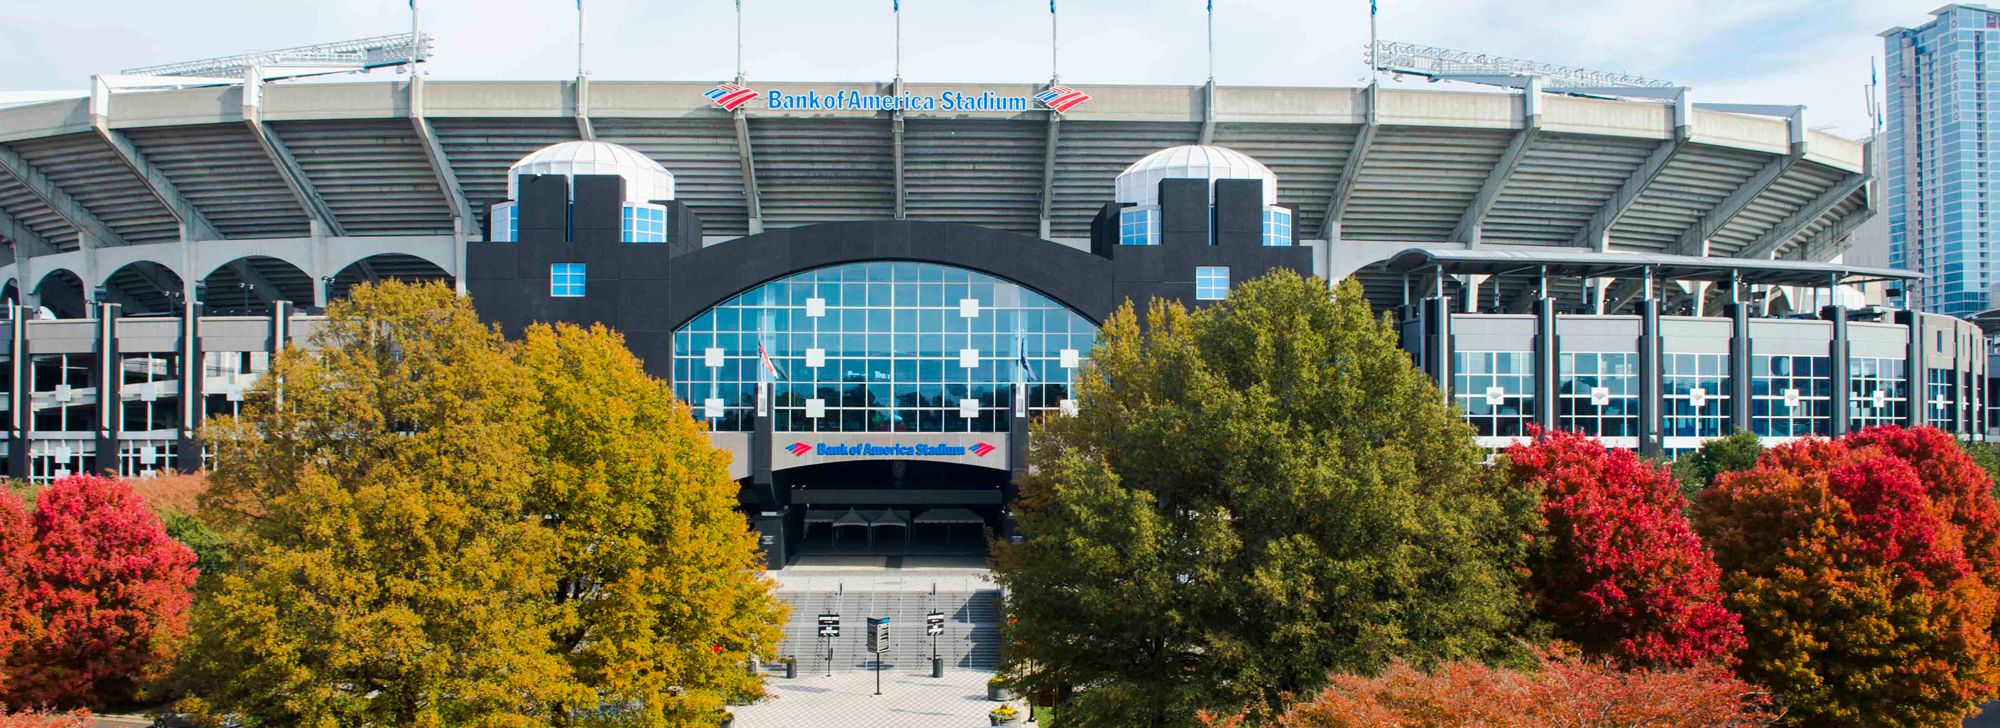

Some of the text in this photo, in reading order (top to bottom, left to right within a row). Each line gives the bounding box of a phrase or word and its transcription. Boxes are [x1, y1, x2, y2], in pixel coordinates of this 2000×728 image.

[1950, 9, 1958, 41] NOW
[768, 89, 1027, 111] Bank of America Stadium
[816, 442, 966, 455] Bank of America Stadium
